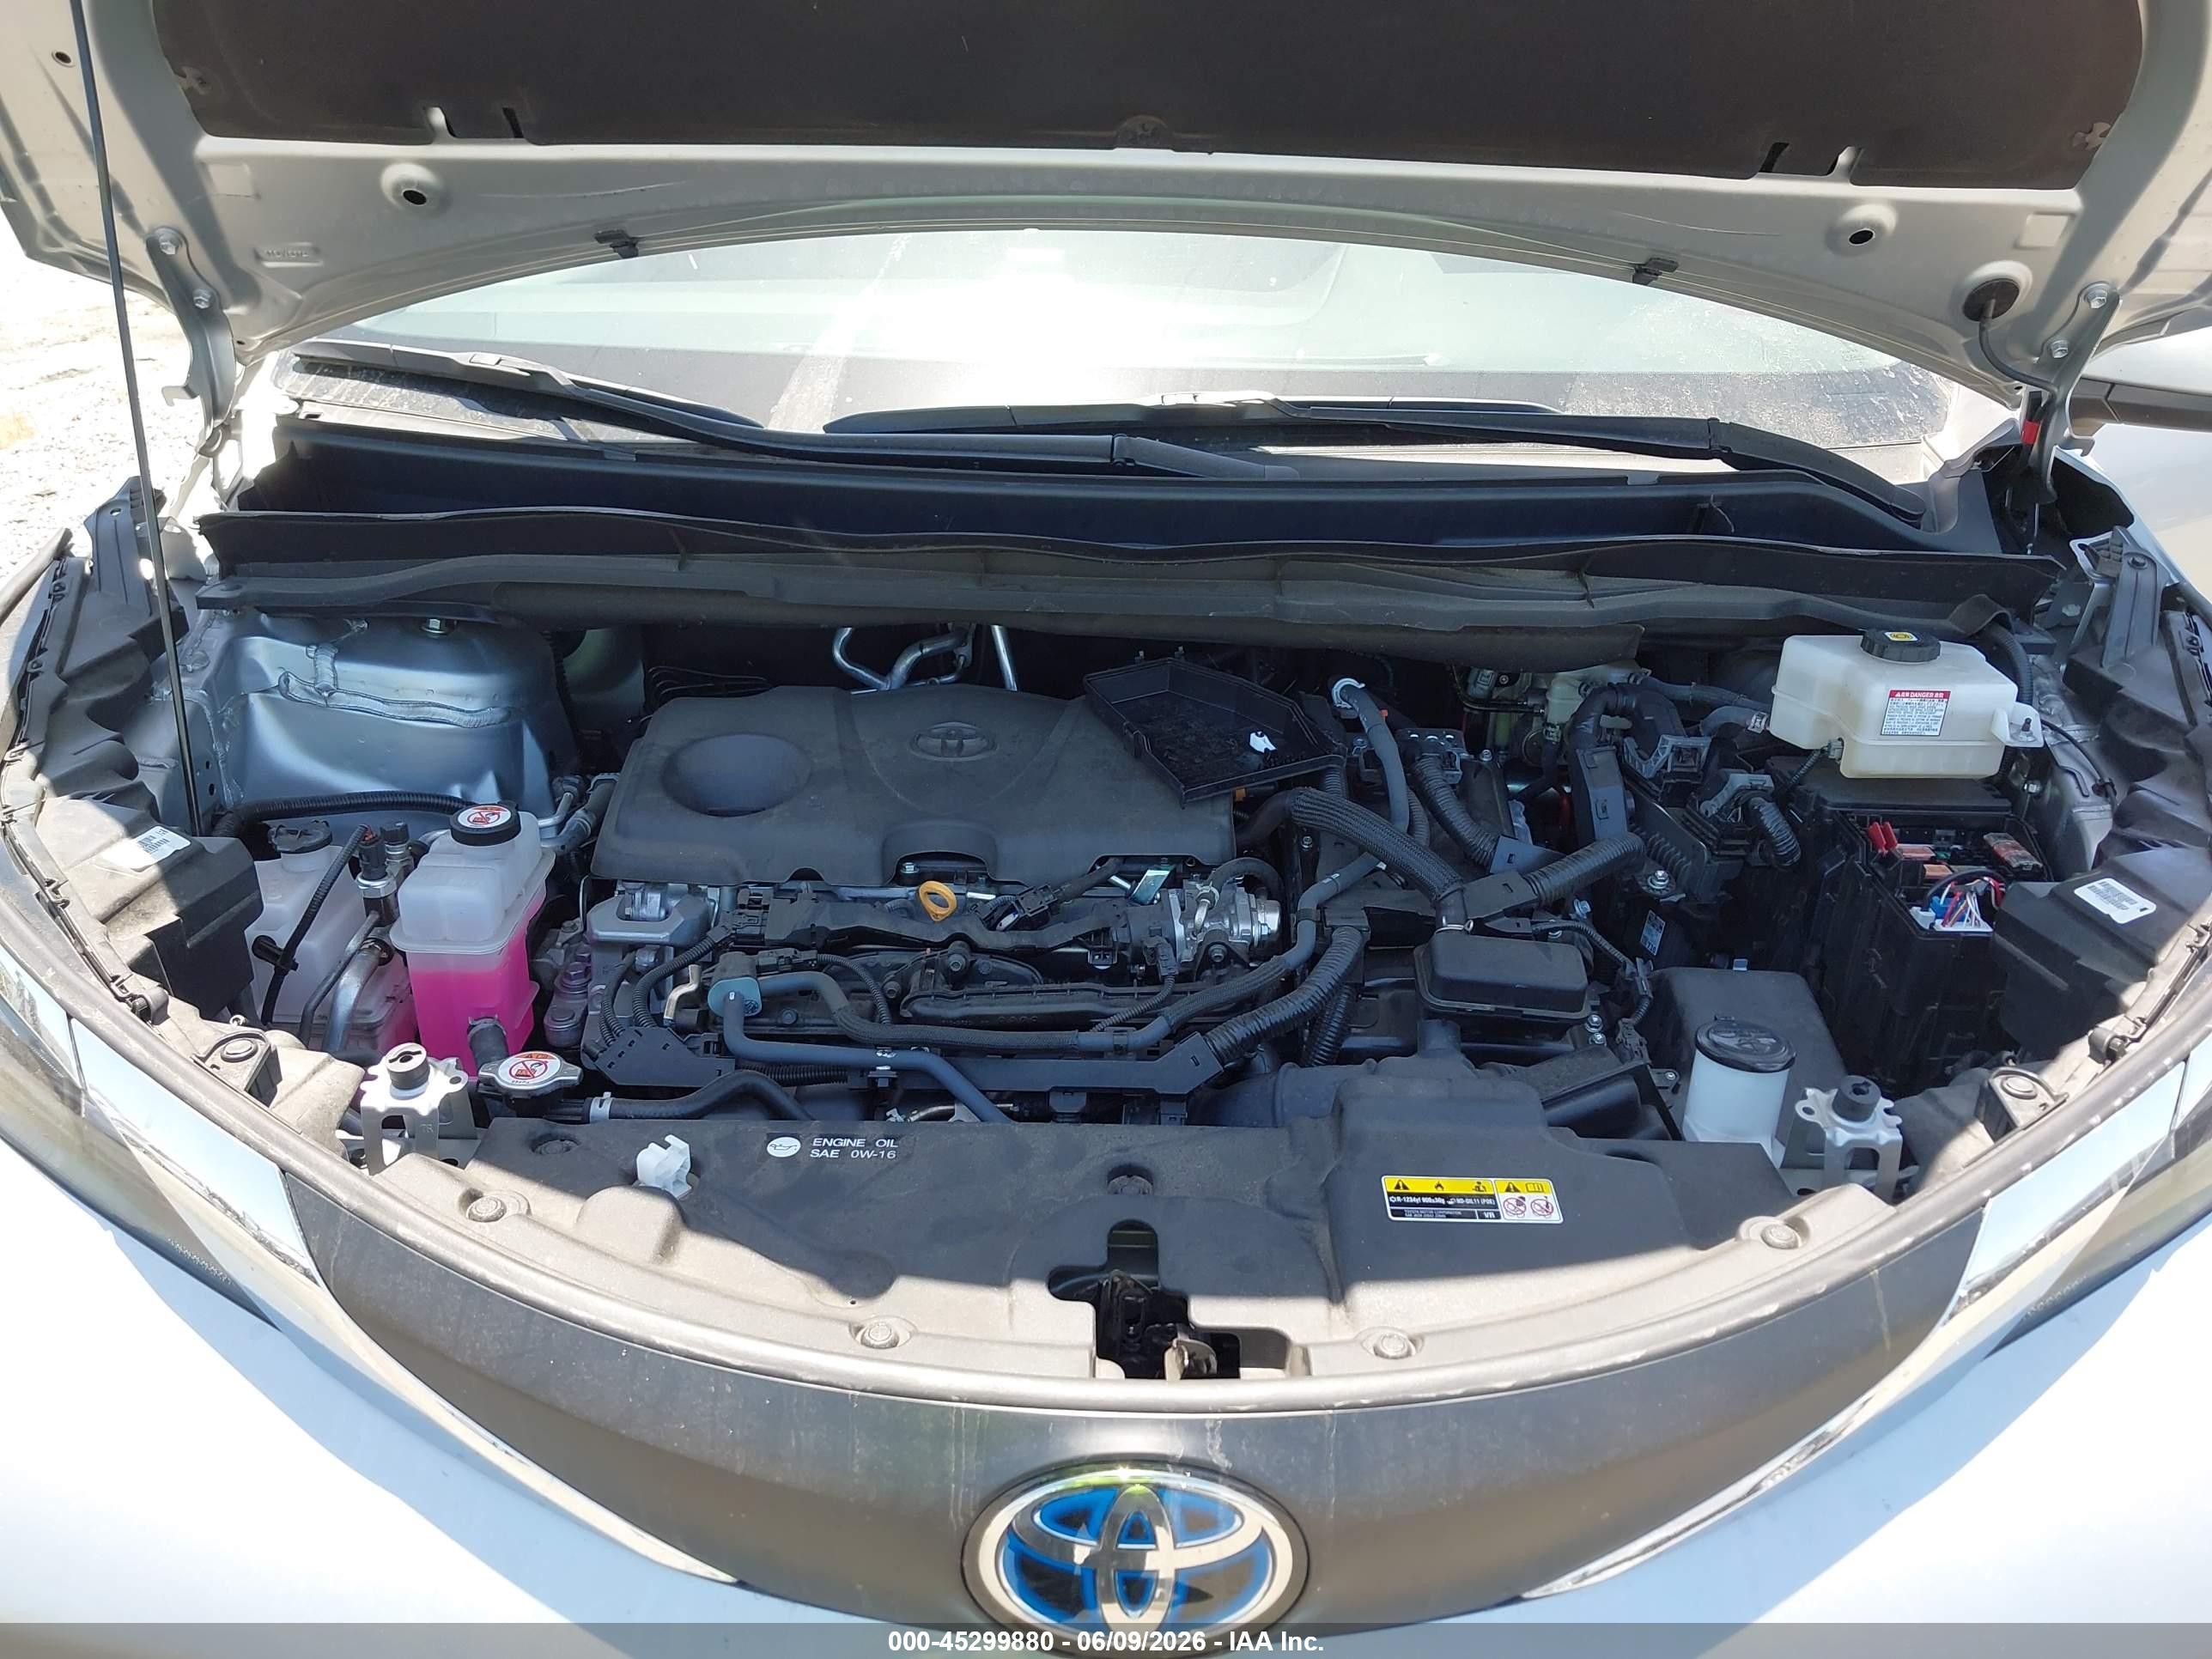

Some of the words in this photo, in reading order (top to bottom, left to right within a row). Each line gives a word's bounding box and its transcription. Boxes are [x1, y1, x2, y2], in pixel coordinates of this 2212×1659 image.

[812, 1138, 866, 1147] ENGINE
[875, 1139, 899, 1148] OIL
[810, 1149, 841, 1158] SAE
[850, 1149, 896, 1159] 0W-16
